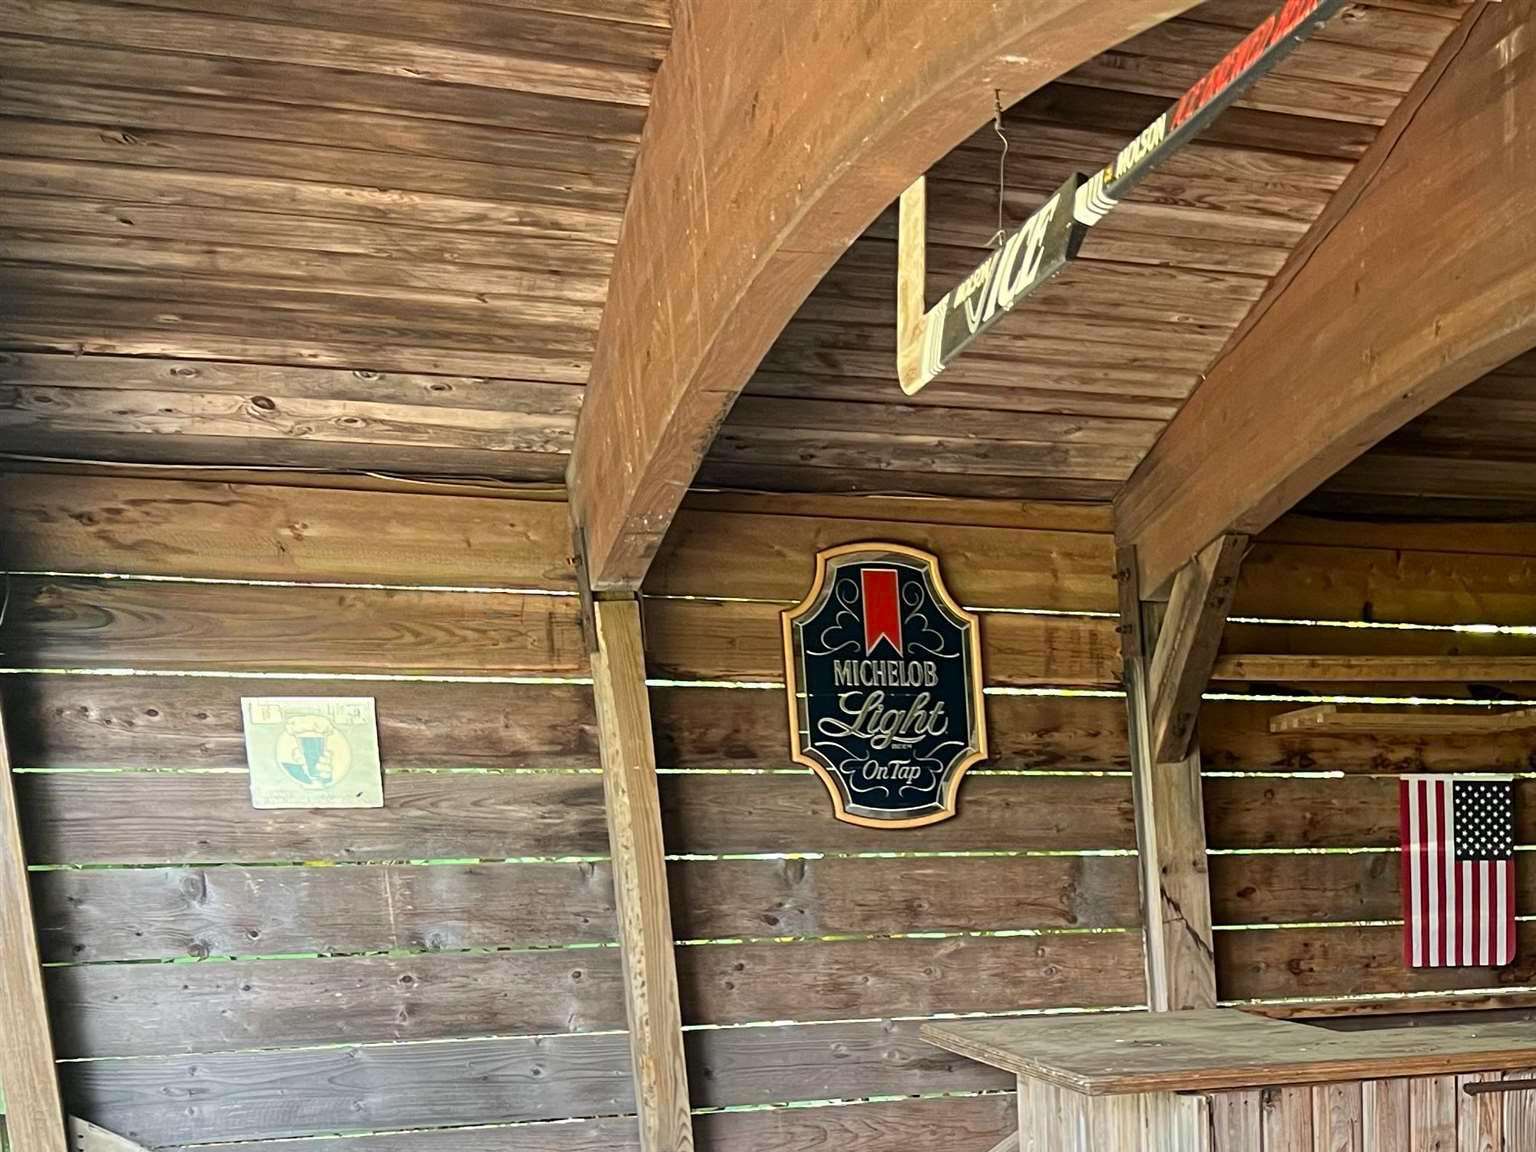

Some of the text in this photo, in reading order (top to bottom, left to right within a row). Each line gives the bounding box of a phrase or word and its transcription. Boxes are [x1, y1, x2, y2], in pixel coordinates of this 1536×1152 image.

[833, 659, 939, 688] MICHELOB
[818, 690, 949, 750] Light
[862, 760, 921, 784] On Tap
